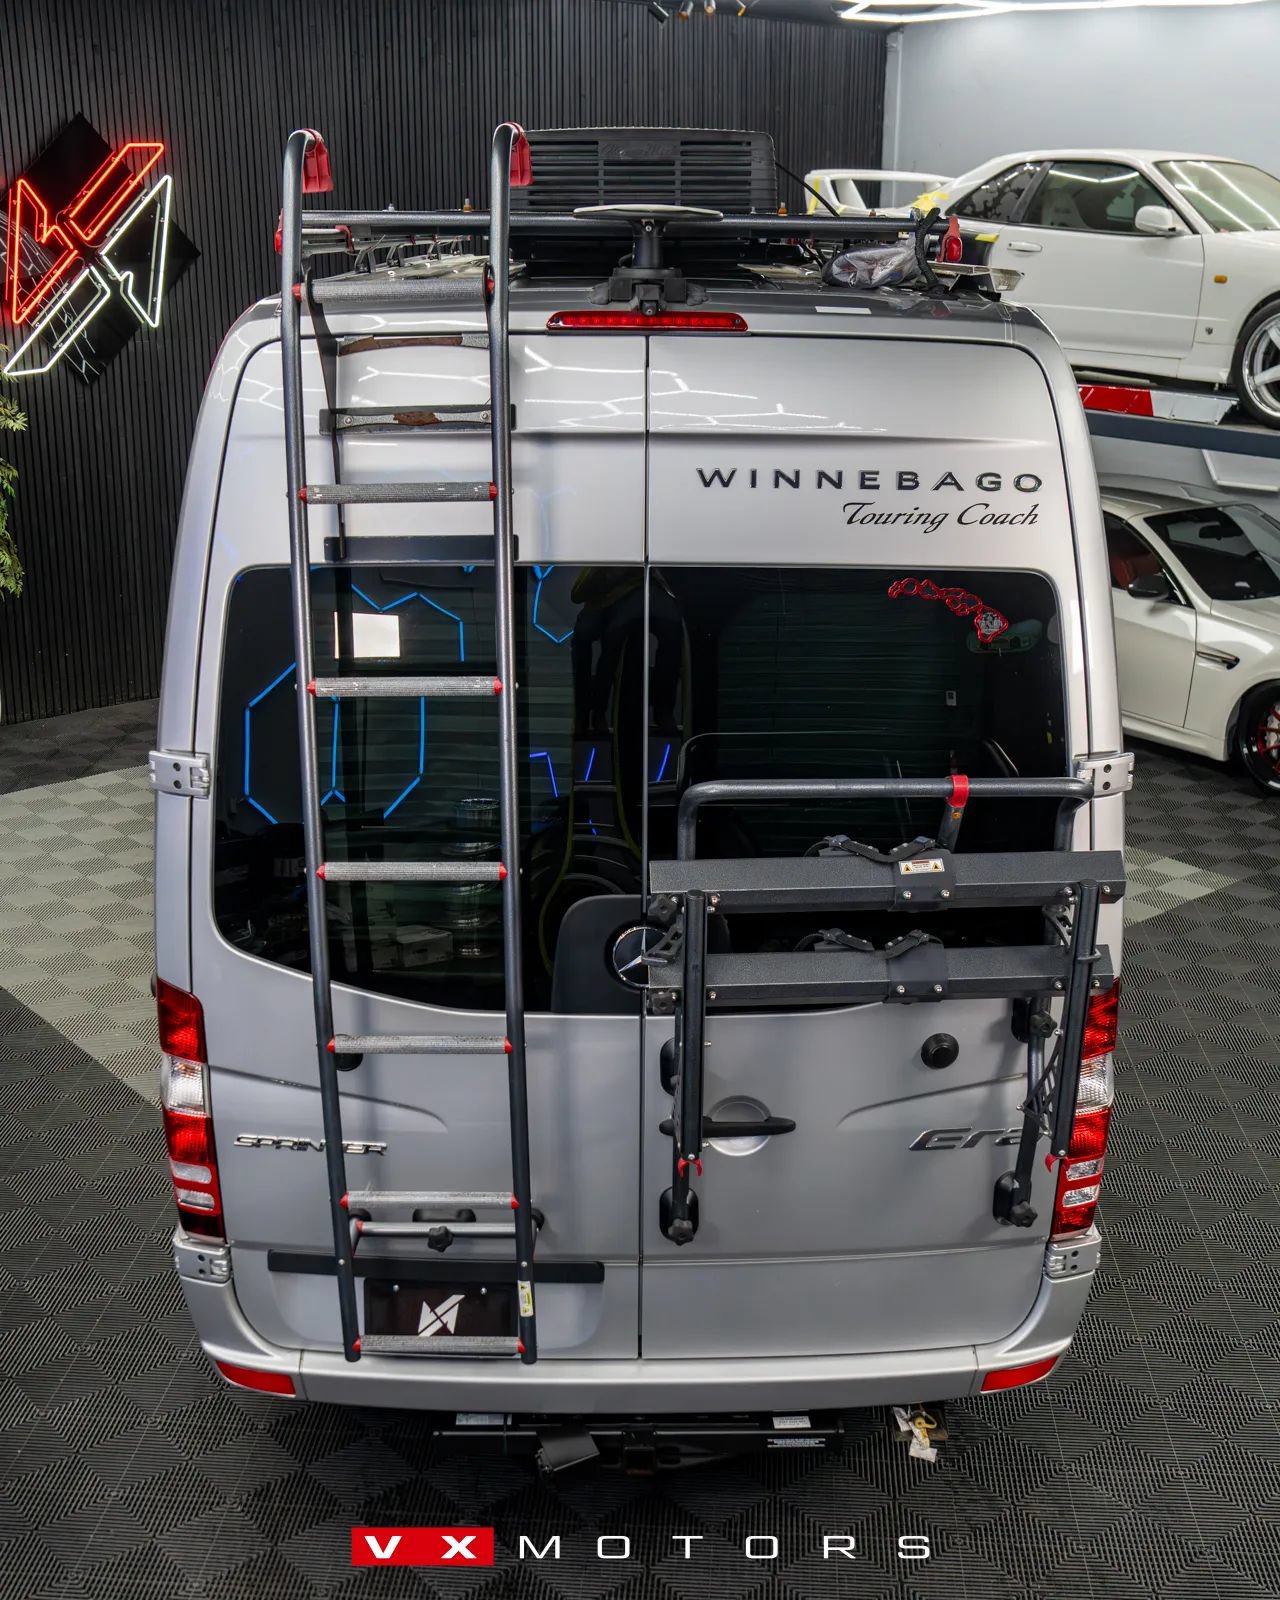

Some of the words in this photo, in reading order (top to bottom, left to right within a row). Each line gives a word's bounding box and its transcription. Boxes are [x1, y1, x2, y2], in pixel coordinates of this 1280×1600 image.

[695, 467, 1043, 493] WINNEBAGO
[842, 501, 949, 534] Touring
[956, 502, 1041, 526] Coach
[233, 1133, 388, 1156] SPRINER
